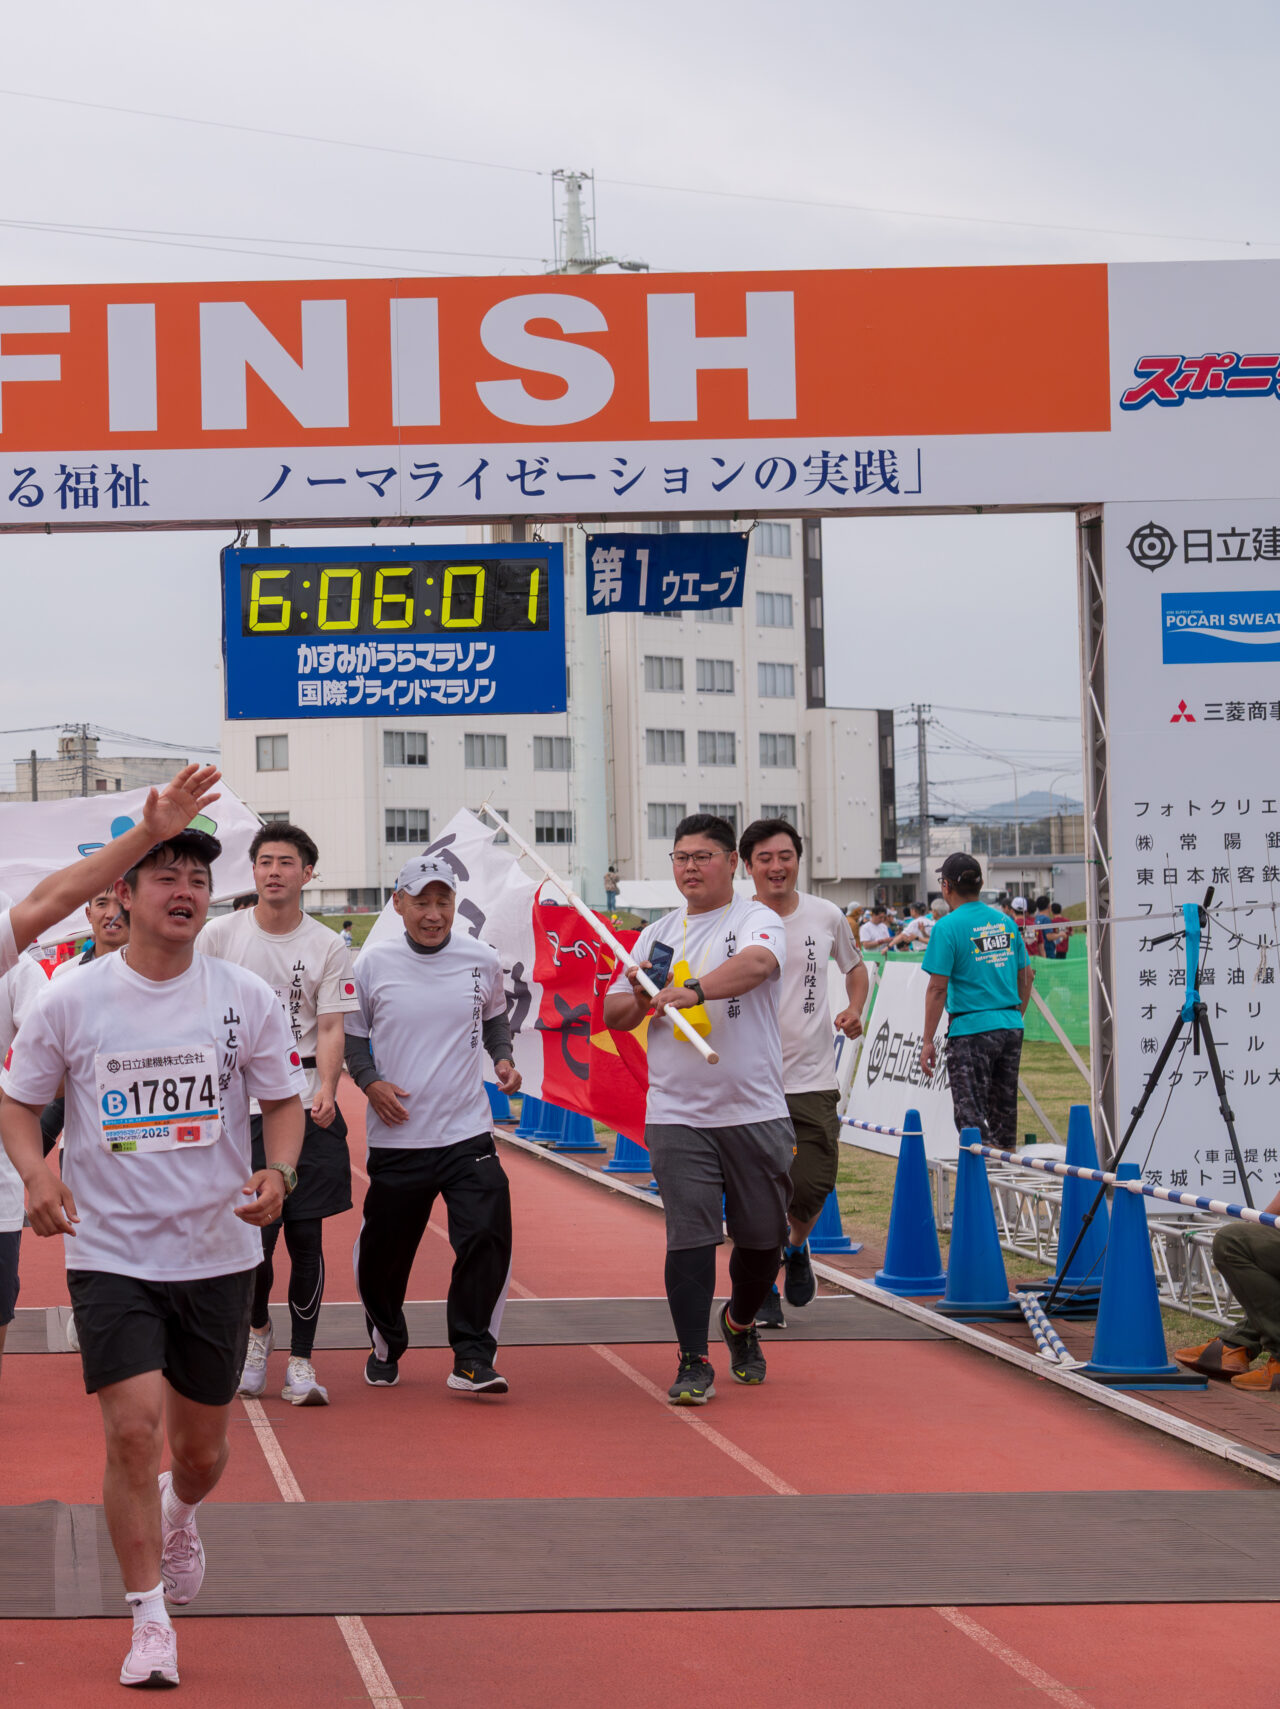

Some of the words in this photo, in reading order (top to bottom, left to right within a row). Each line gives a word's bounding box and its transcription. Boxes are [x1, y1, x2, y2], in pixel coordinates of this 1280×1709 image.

[1120, 353, 1280, 410] スポニ
[258, 448, 921, 503] ノーマライゼーションの実践」
[248, 565, 539, 632] 6:06:01
[1166, 614, 1225, 627] POCARI
[297, 641, 495, 674] かすみがうらマラソン
[297, 677, 496, 706] 国際ブラインドマラソン
[1134, 799, 1277, 817] フォトクリエ
[1136, 865, 1280, 885] 東日本旅客鉄
[803, 936, 816, 1014] 山と川陸上部
[1141, 1002, 1262, 1020] オトリ
[122, 1052, 206, 1071] 日立建機株式会社
[107, 1093, 124, 1114] B
[129, 1074, 215, 1115] 17874
[141, 1126, 170, 1139] 2025
